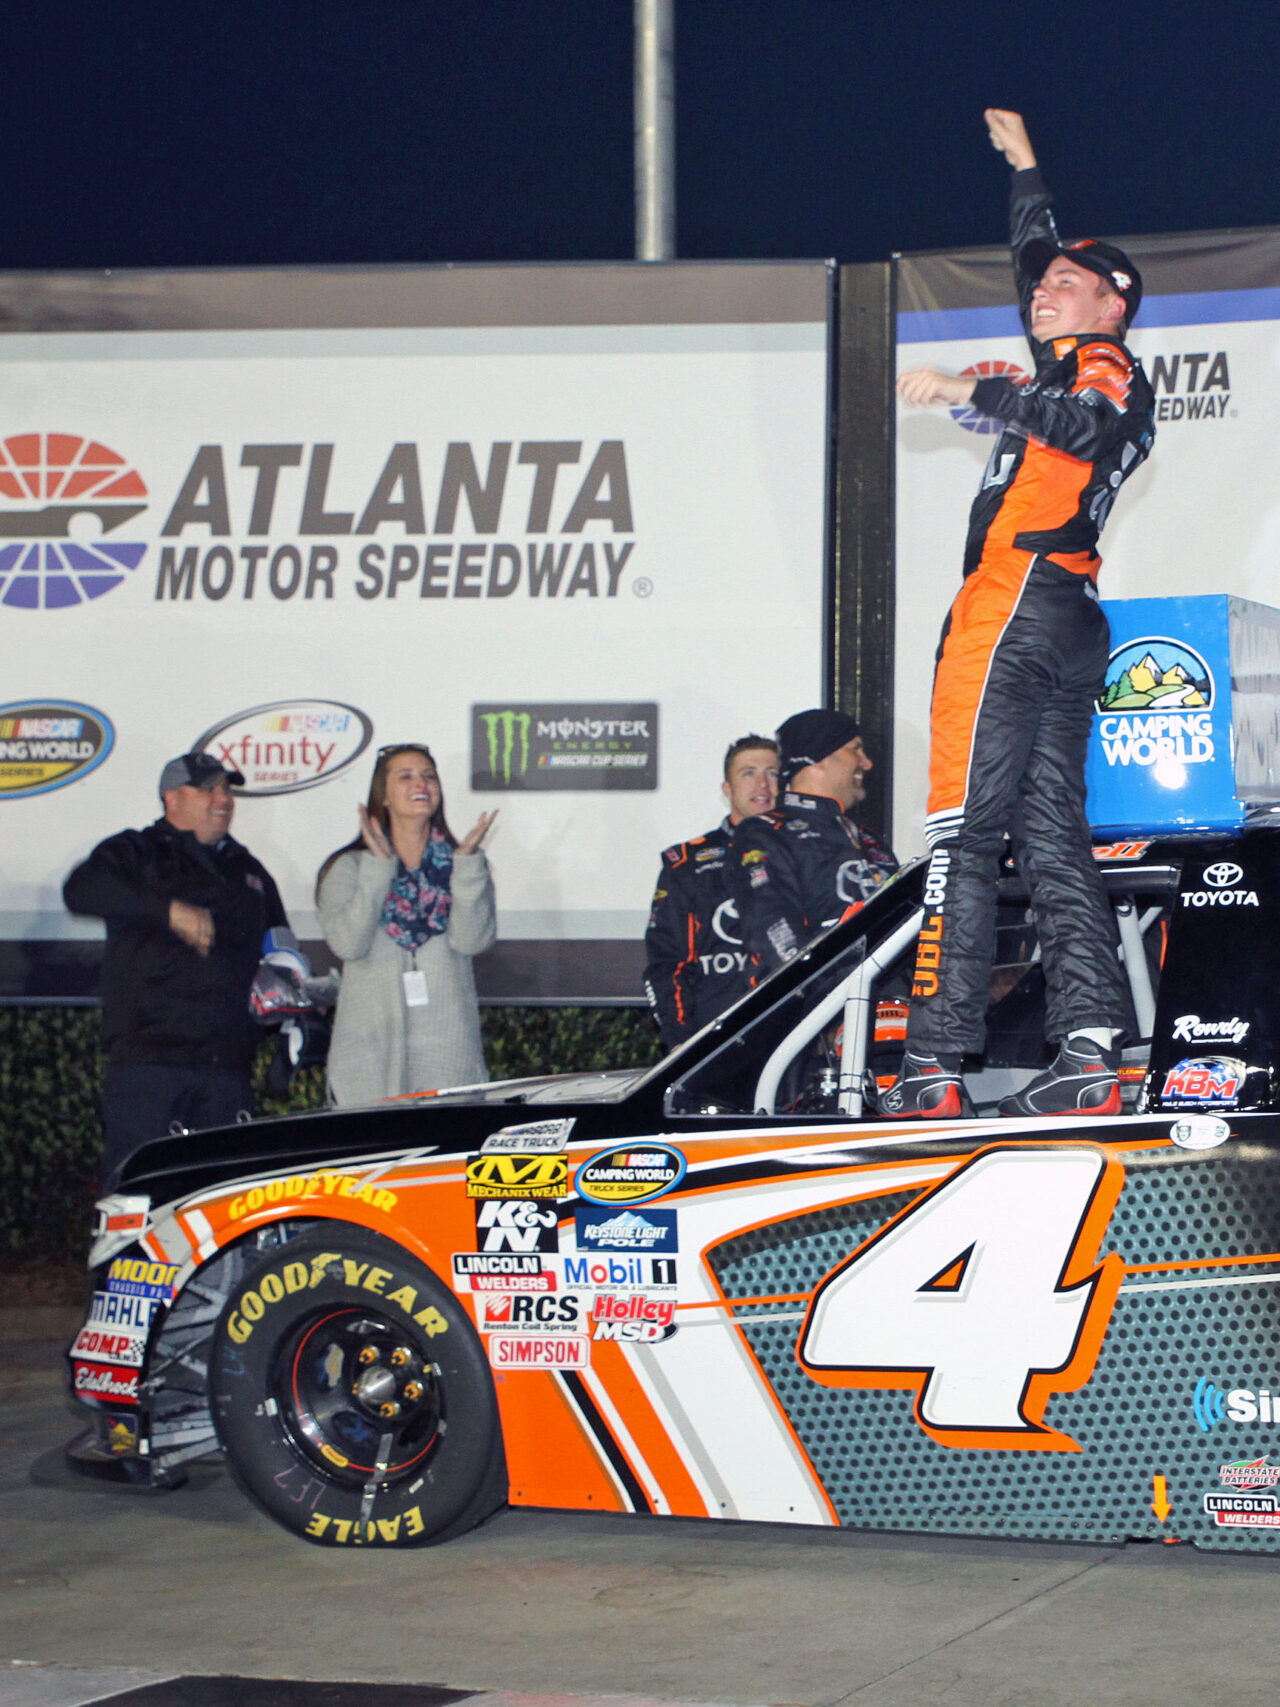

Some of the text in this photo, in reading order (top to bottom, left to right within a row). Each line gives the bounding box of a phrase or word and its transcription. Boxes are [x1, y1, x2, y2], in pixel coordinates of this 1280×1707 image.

[160, 440, 635, 537] ATLANTA
[155, 542, 635, 600] MOTOR SPEEDWAY
[537, 717, 650, 739] MONSTER
[1100, 713, 1213, 740] CAMPING
[28, 741, 95, 759] WORLD
[219, 735, 336, 773] xfinity
[1181, 889, 1260, 907] TOYOTA
[1172, 1014, 1250, 1043] Rowdy
[1161, 1066, 1238, 1099] KBM
[488, 1137, 559, 1147] RACE TRUCK
[628, 1154, 667, 1166] NASCAR
[586, 1168, 675, 1181] CAMPING WORLD
[228, 1168, 398, 1220] GOODYEAR
[467, 1184, 568, 1198] MECHANIX WEAR
[617, 1184, 646, 1192] SERIES
[584, 1224, 669, 1240] KEYSTONE LIGHT
[597, 1239, 656, 1247] POLE
[456, 1256, 539, 1274] LINCOLN
[564, 1258, 669, 1283] Mobil 1
[476, 1276, 549, 1290] WELDERS
[227, 1253, 449, 1344] GOODYEAR
[797, 1142, 1124, 1450] 4
[512, 1295, 579, 1322] RCS
[594, 1295, 676, 1326] Holley
[543, 1323, 577, 1332] Spring
[592, 1321, 666, 1344] MSD
[78, 1331, 130, 1355] COMP
[499, 1341, 580, 1363] SIMPSON
[75, 1366, 139, 1398] Edelbrock
[1222, 1468, 1279, 1476] INTERSTATE
[1224, 1476, 1276, 1485] BATTERIES
[1209, 1498, 1273, 1512] LINCOLN
[304, 1505, 425, 1544] EAGLE
